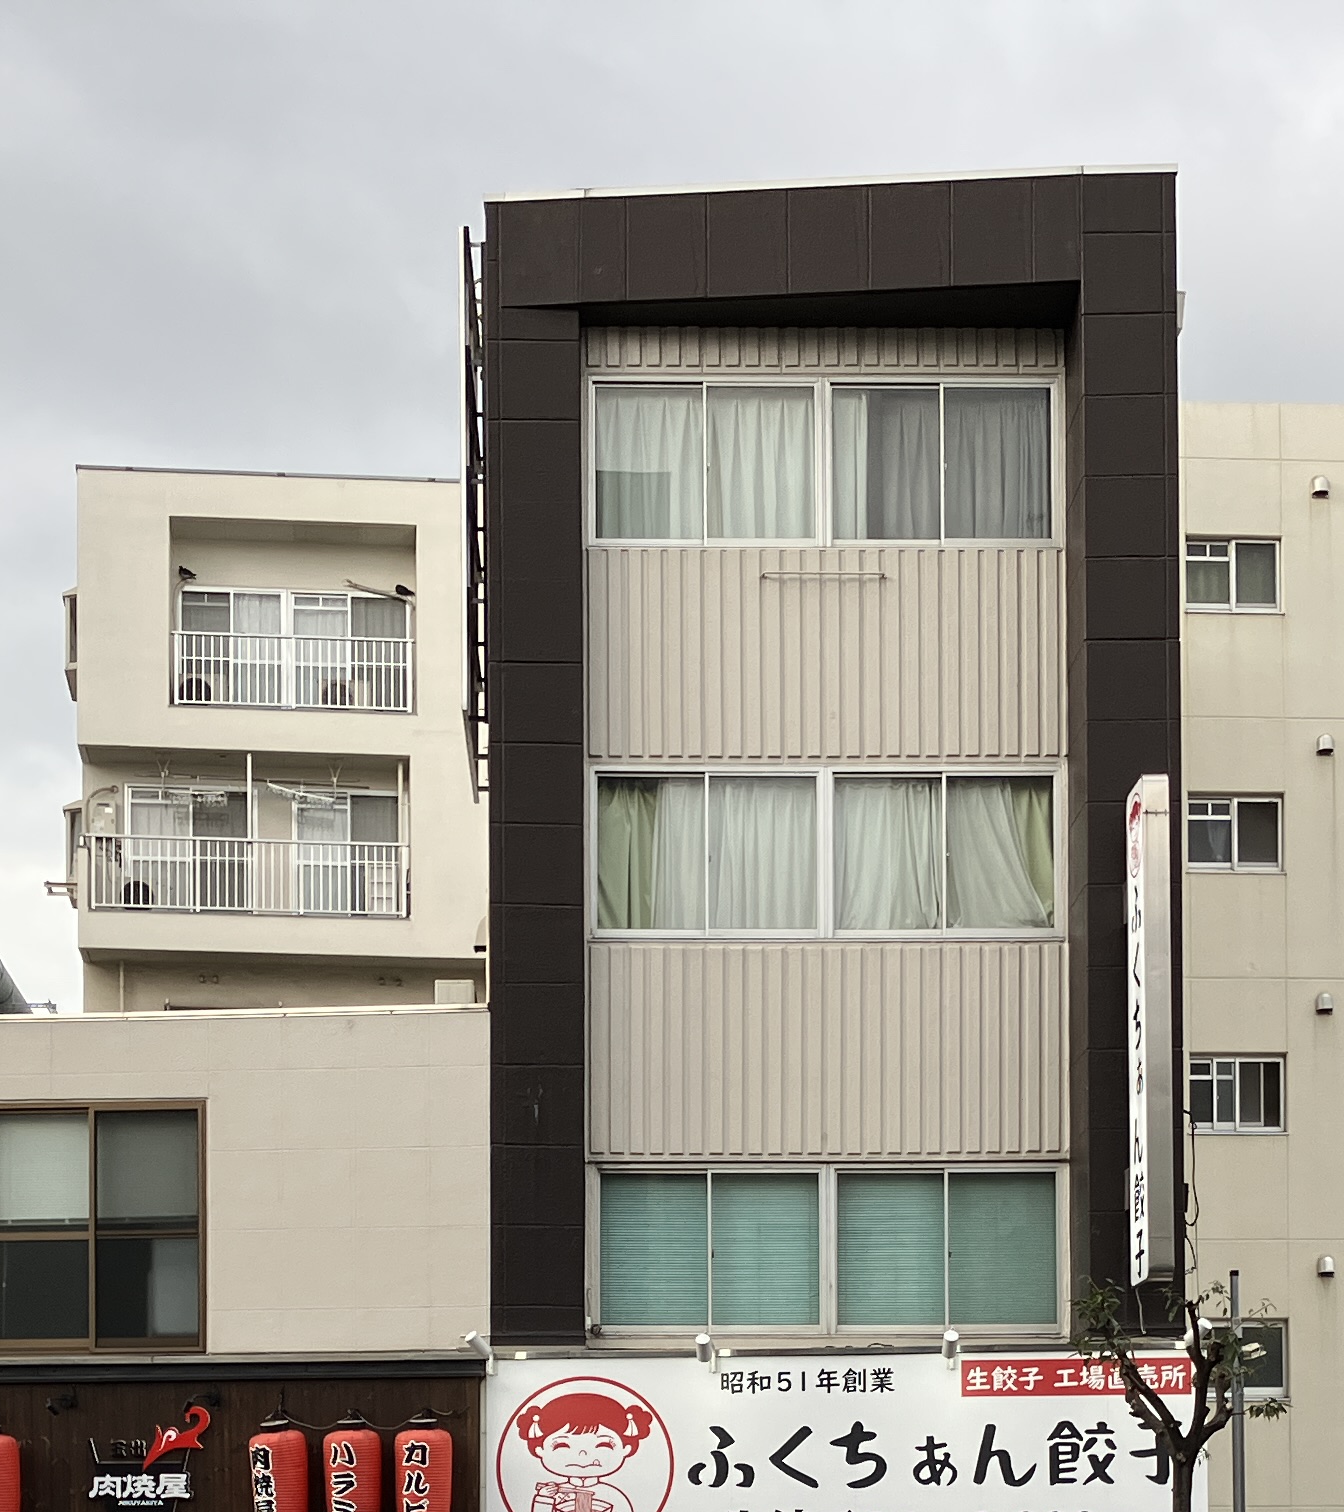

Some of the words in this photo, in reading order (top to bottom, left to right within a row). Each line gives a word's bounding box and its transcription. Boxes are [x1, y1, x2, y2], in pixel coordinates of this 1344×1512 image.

[1131, 887, 1145, 1278] ふくちぁん餃子
[720, 1367, 896, 1394] 昭和51年創業
[965, 1365, 1044, 1392] 生餃子
[1054, 1363, 1186, 1391] 工場直売所
[88, 1473, 192, 1499] 肉焼屋
